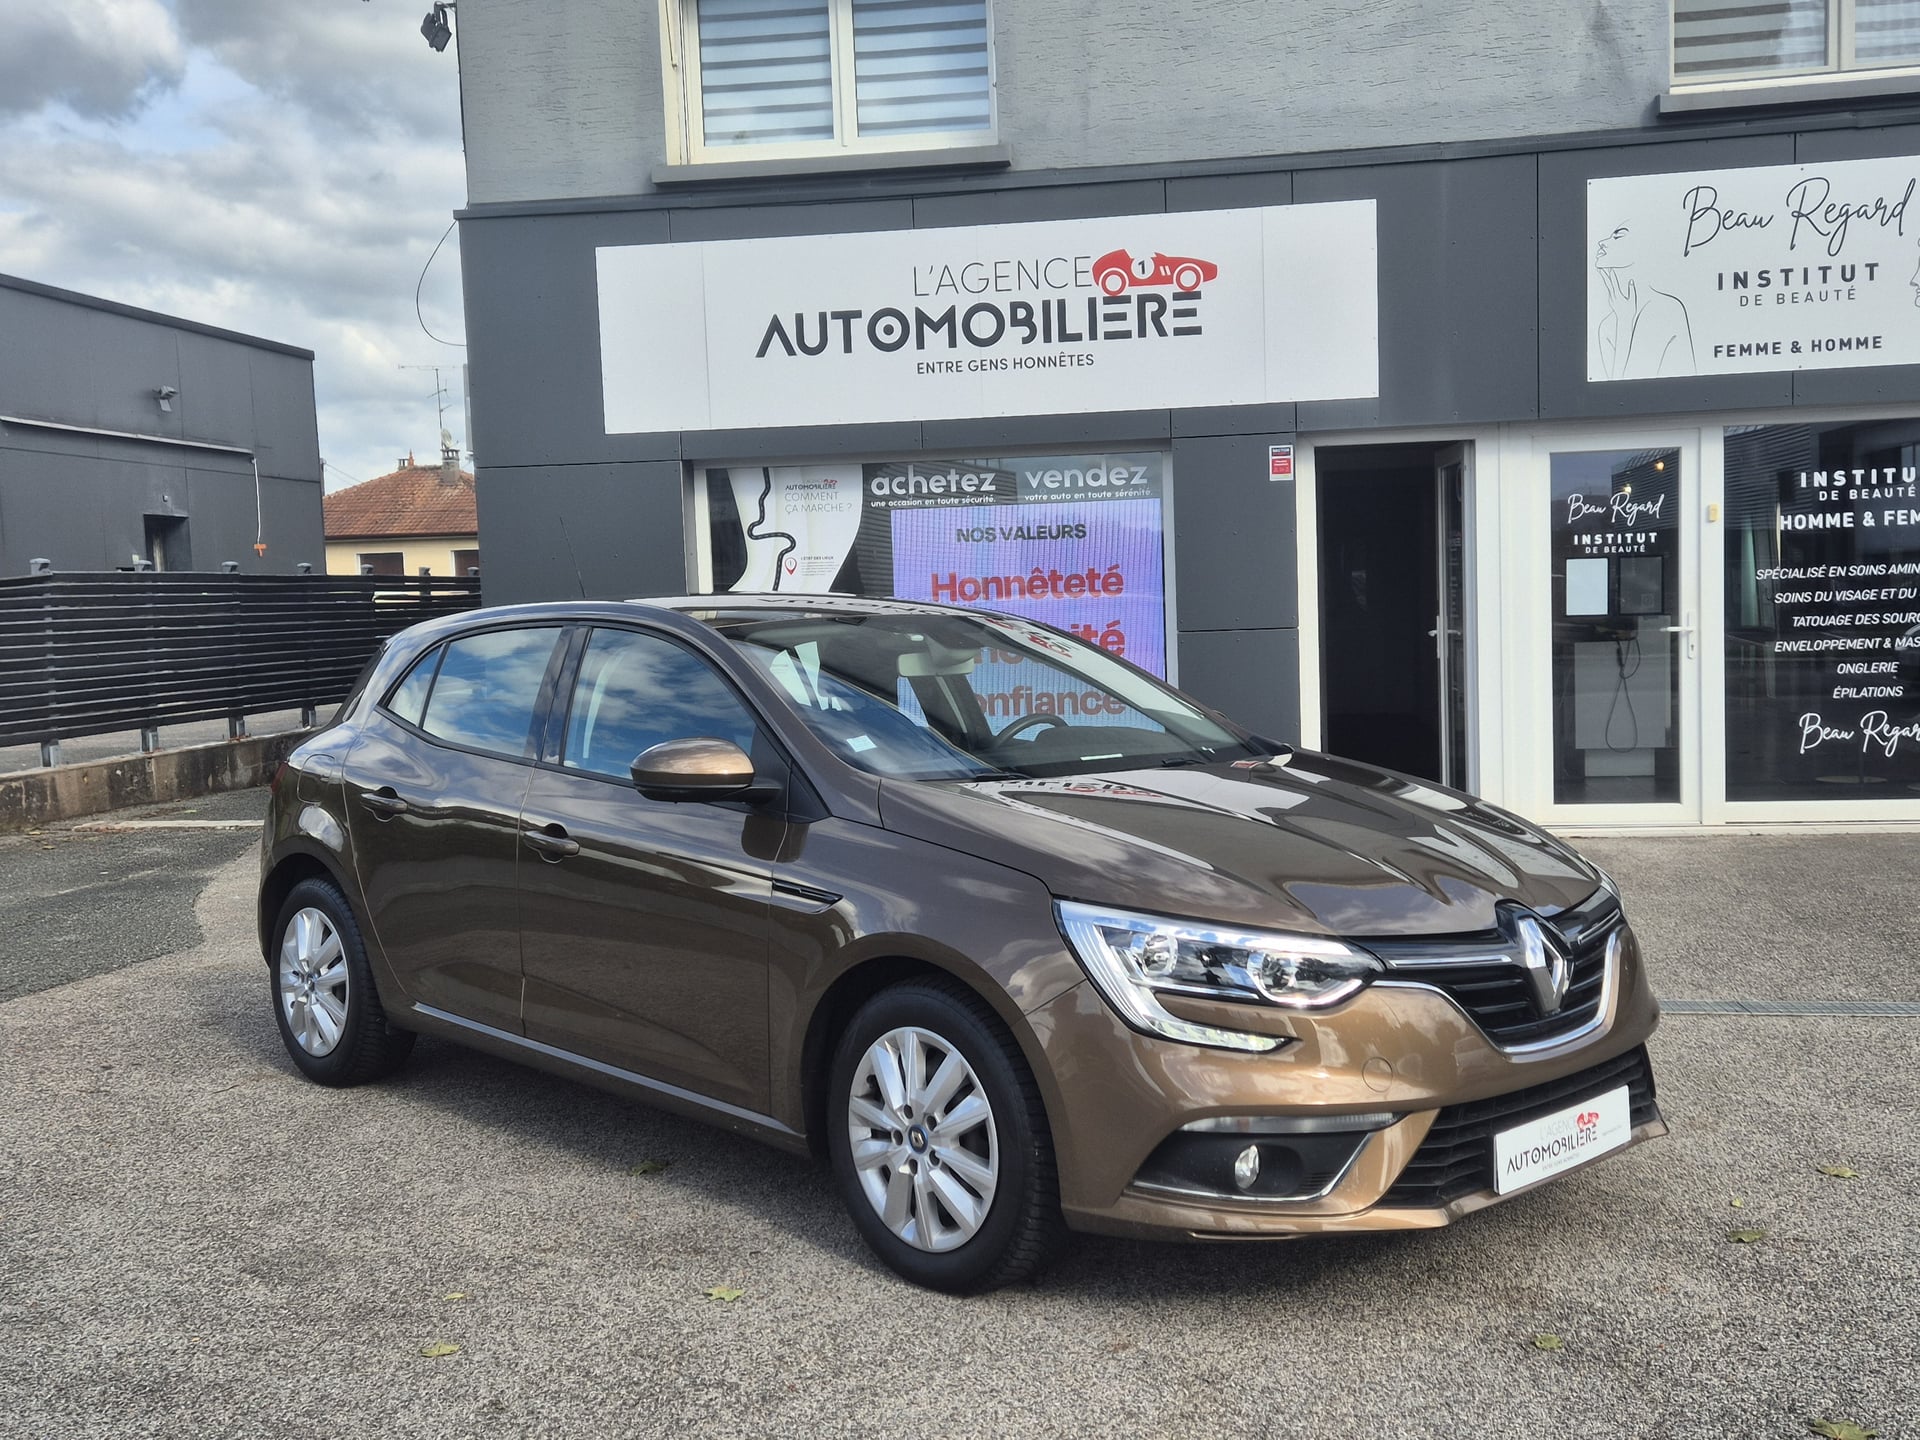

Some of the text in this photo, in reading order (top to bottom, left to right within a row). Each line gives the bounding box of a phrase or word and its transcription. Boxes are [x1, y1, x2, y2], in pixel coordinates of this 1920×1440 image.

[1683, 177, 1916, 257] Beau Regard
[913, 256, 1093, 298] L'AGENCE
[1717, 262, 1880, 291] INSTITUT
[1739, 286, 1857, 307] DE BEAUTÉ
[1713, 335, 1883, 359] FEMME & HOMME
[916, 351, 1095, 375] ENTRE GENS HONNÊTES
[870, 465, 997, 497] achetez
[1024, 455, 1149, 490] vendez
[1800, 466, 1916, 488] INSTITU
[784, 491, 840, 501] COMMENT
[888, 497, 923, 507] occasion
[937, 496, 960, 505] toute
[961, 494, 998, 505] sécurité.
[1024, 493, 1049, 502] votre
[1050, 492, 1072, 500] auto
[1073, 491, 1086, 499] en
[1087, 489, 1113, 499] toute
[1819, 484, 1916, 501] DE BEAUTÉ
[801, 502, 845, 513] MARCHE
[1567, 491, 1665, 526] Beau Regard
[1780, 512, 1855, 531] HOMME
[1862, 511, 1875, 527] &
[956, 523, 1087, 543] NOS VALEURS
[1573, 532, 1658, 545] INSTITUT
[1585, 543, 1646, 554] DE BEAUTÉ
[1756, 564, 1827, 581] SPÉCIALISÉ
[1828, 567, 1847, 577] EN
[1848, 563, 1887, 577] SOINS
[931, 564, 1124, 602] Honnêteté
[1774, 587, 1917, 604] SOINS DU VISAGE ET DU
[1792, 614, 1853, 627] TATOUAGE
[1855, 613, 1880, 625] DES
[1774, 637, 1882, 653] ENVELOPPEMENT
[1882, 637, 1892, 648] &
[1836, 661, 1900, 675] ONGLERIE
[1832, 685, 1904, 699] ÉPILATIONS
[1799, 712, 1855, 755] Beau
